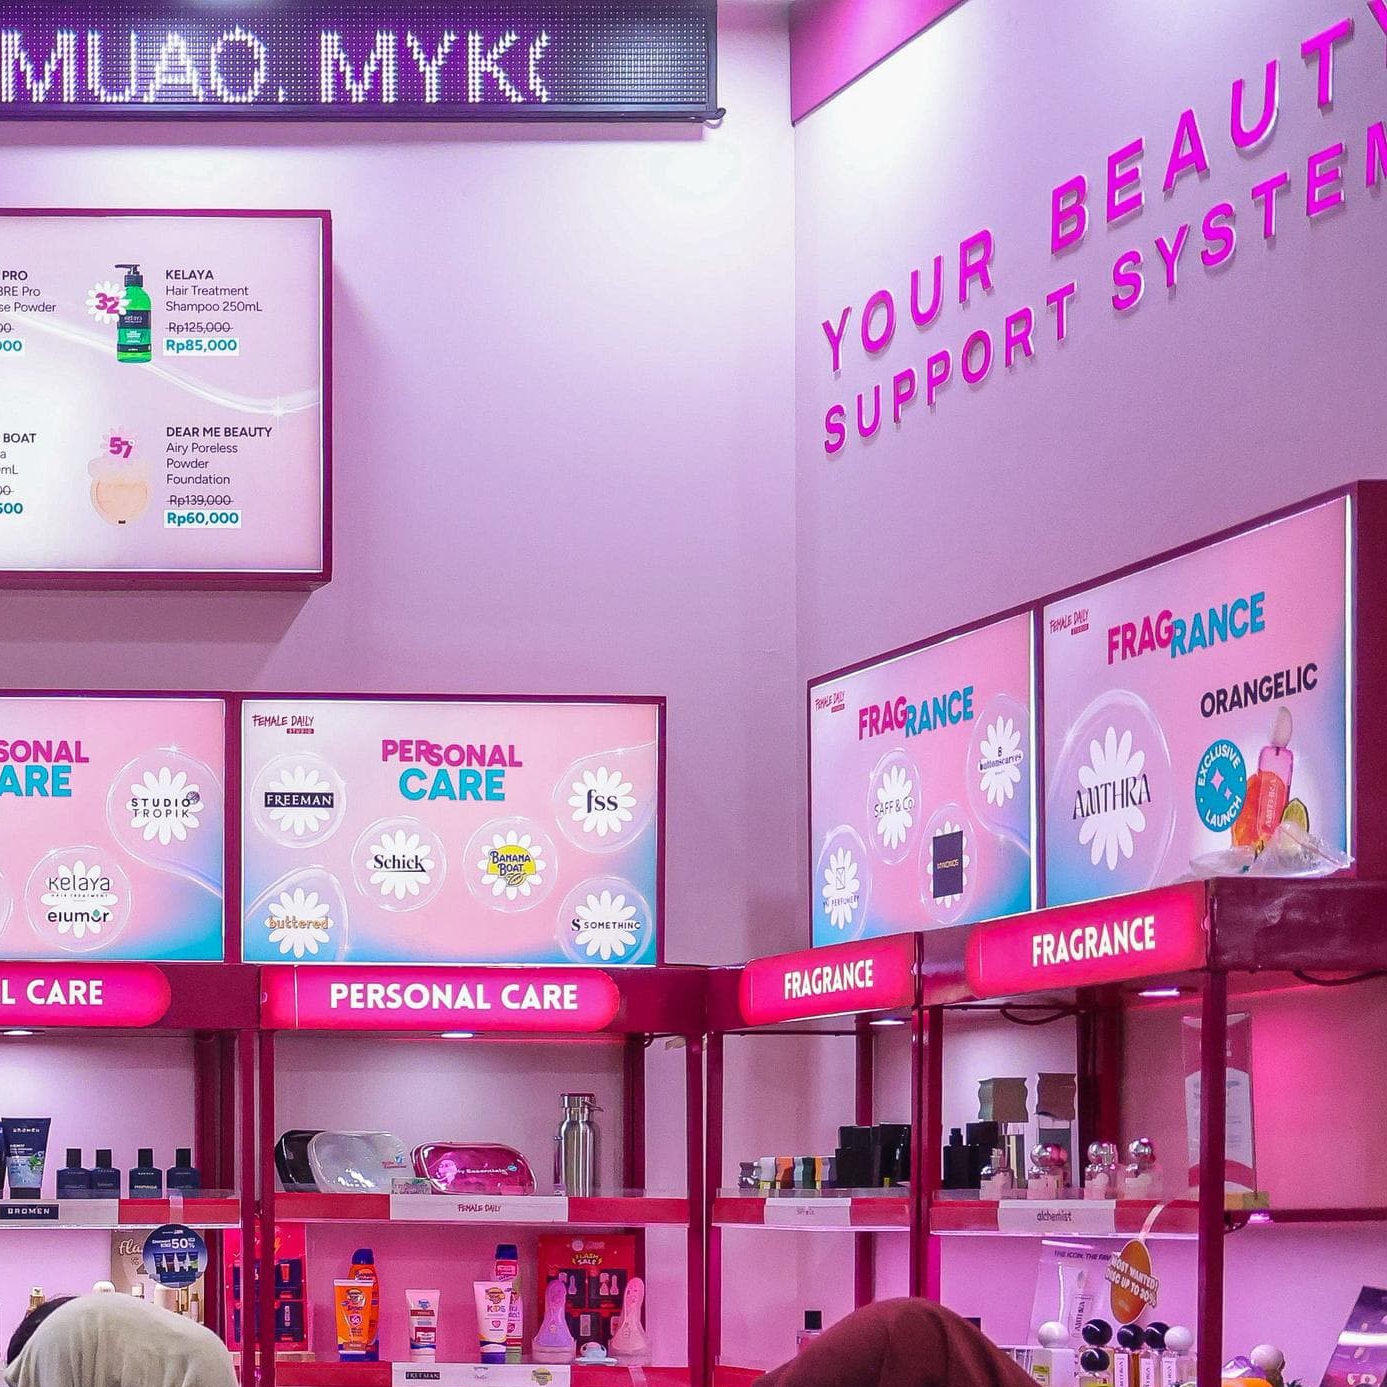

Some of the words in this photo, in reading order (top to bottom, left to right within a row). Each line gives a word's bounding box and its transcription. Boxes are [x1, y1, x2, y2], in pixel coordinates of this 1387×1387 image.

[2, 270, 29, 281] PRO
[165, 269, 215, 281] KELAYA
[165, 284, 189, 296] Hair
[190, 284, 249, 296] Treatment
[13, 301, 57, 313] Powder
[165, 300, 220, 314] Shampoo
[222, 300, 263, 312] 250mL
[822, 229, 993, 373] YOUR
[166, 338, 238, 354] Rp85,000
[824, 281, 1076, 454] SUPPORT
[3, 432, 37, 444] BOAT
[166, 426, 200, 438] DEAR
[202, 426, 221, 438] ME
[223, 426, 273, 438] BEAUTY
[165, 442, 189, 456] Airy
[191, 442, 239, 454] Poreless
[166, 457, 210, 469] Powder
[166, 473, 231, 485] Foundation
[167, 511, 239, 527] Rp60,000
[1108, 591, 1265, 665] FRAGRANCE
[1200, 663, 1318, 718] ORANGELIC
[859, 686, 974, 740] FRAGRANCE
[382, 740, 522, 767] PERSONAL
[1198, 744, 1240, 786] EXCLUSIVE
[399, 768, 505, 801] CARE
[131, 797, 191, 807] STUDIO
[266, 795, 333, 807] FREEMAN
[133, 808, 190, 819] TROPIK
[1205, 796, 1242, 828] LAUNCH
[374, 854, 425, 872] Schick
[269, 917, 328, 929] buttered
[1033, 916, 1155, 967] FRAGRANCE
[785, 959, 873, 999] FRAGRANCE
[27, 980, 102, 1004] CARE
[331, 982, 491, 1009] PERSONAL
[501, 983, 577, 1009] CARE
